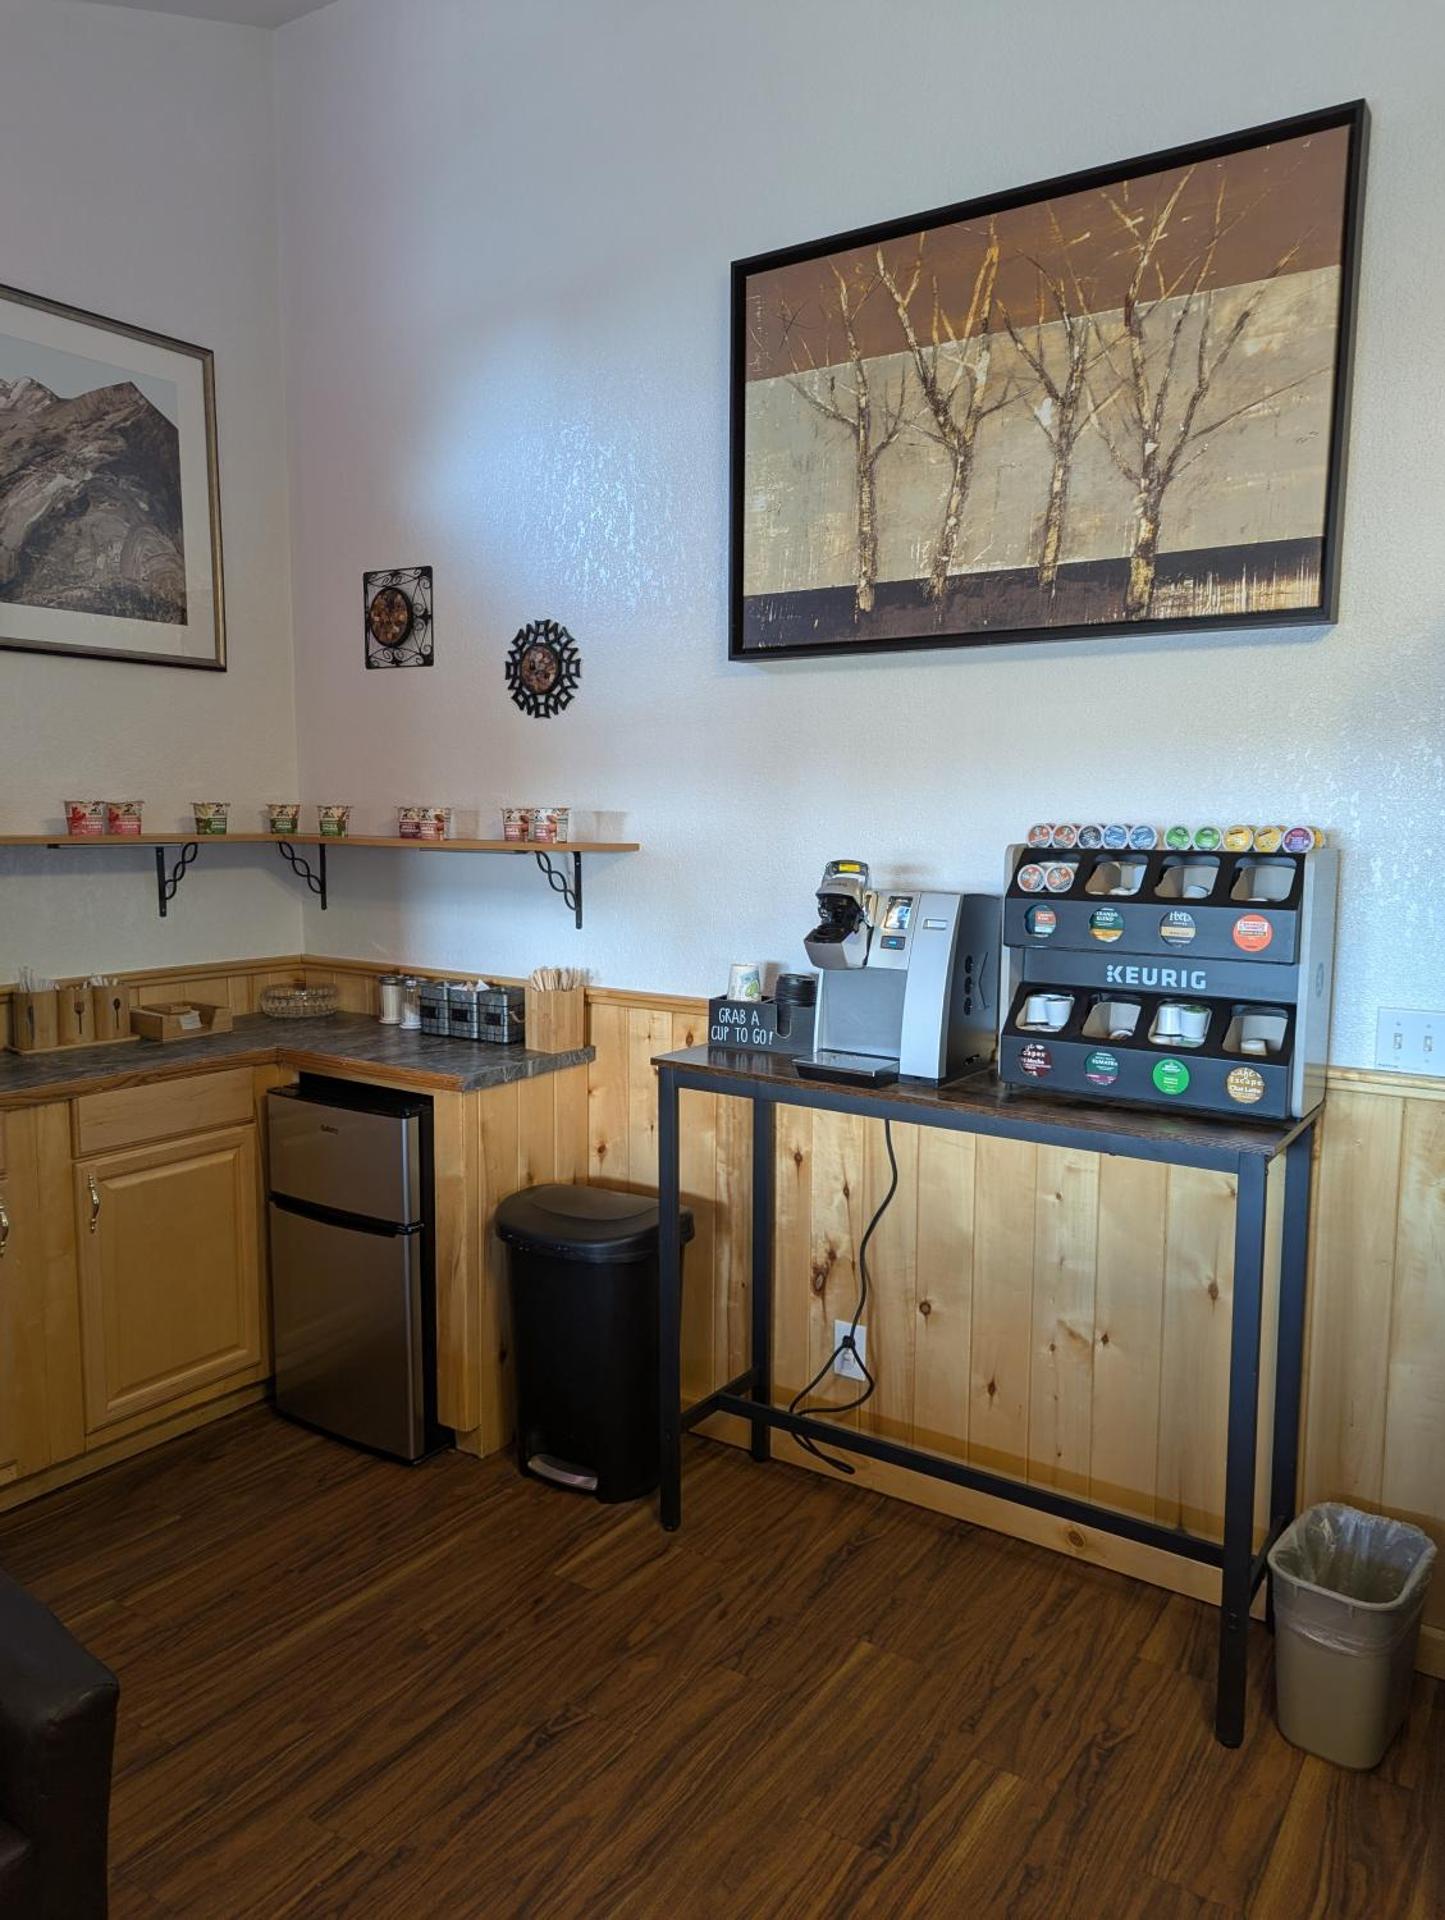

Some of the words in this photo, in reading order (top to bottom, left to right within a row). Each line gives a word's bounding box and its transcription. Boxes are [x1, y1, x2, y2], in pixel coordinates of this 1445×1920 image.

[1106, 964, 1207, 989] KEURIG
[718, 1007, 746, 1025] GRAB
[750, 1009, 760, 1026] A
[711, 1025, 730, 1041] CUP
[734, 1027, 748, 1043] TO
[752, 1028, 774, 1045] GO!
